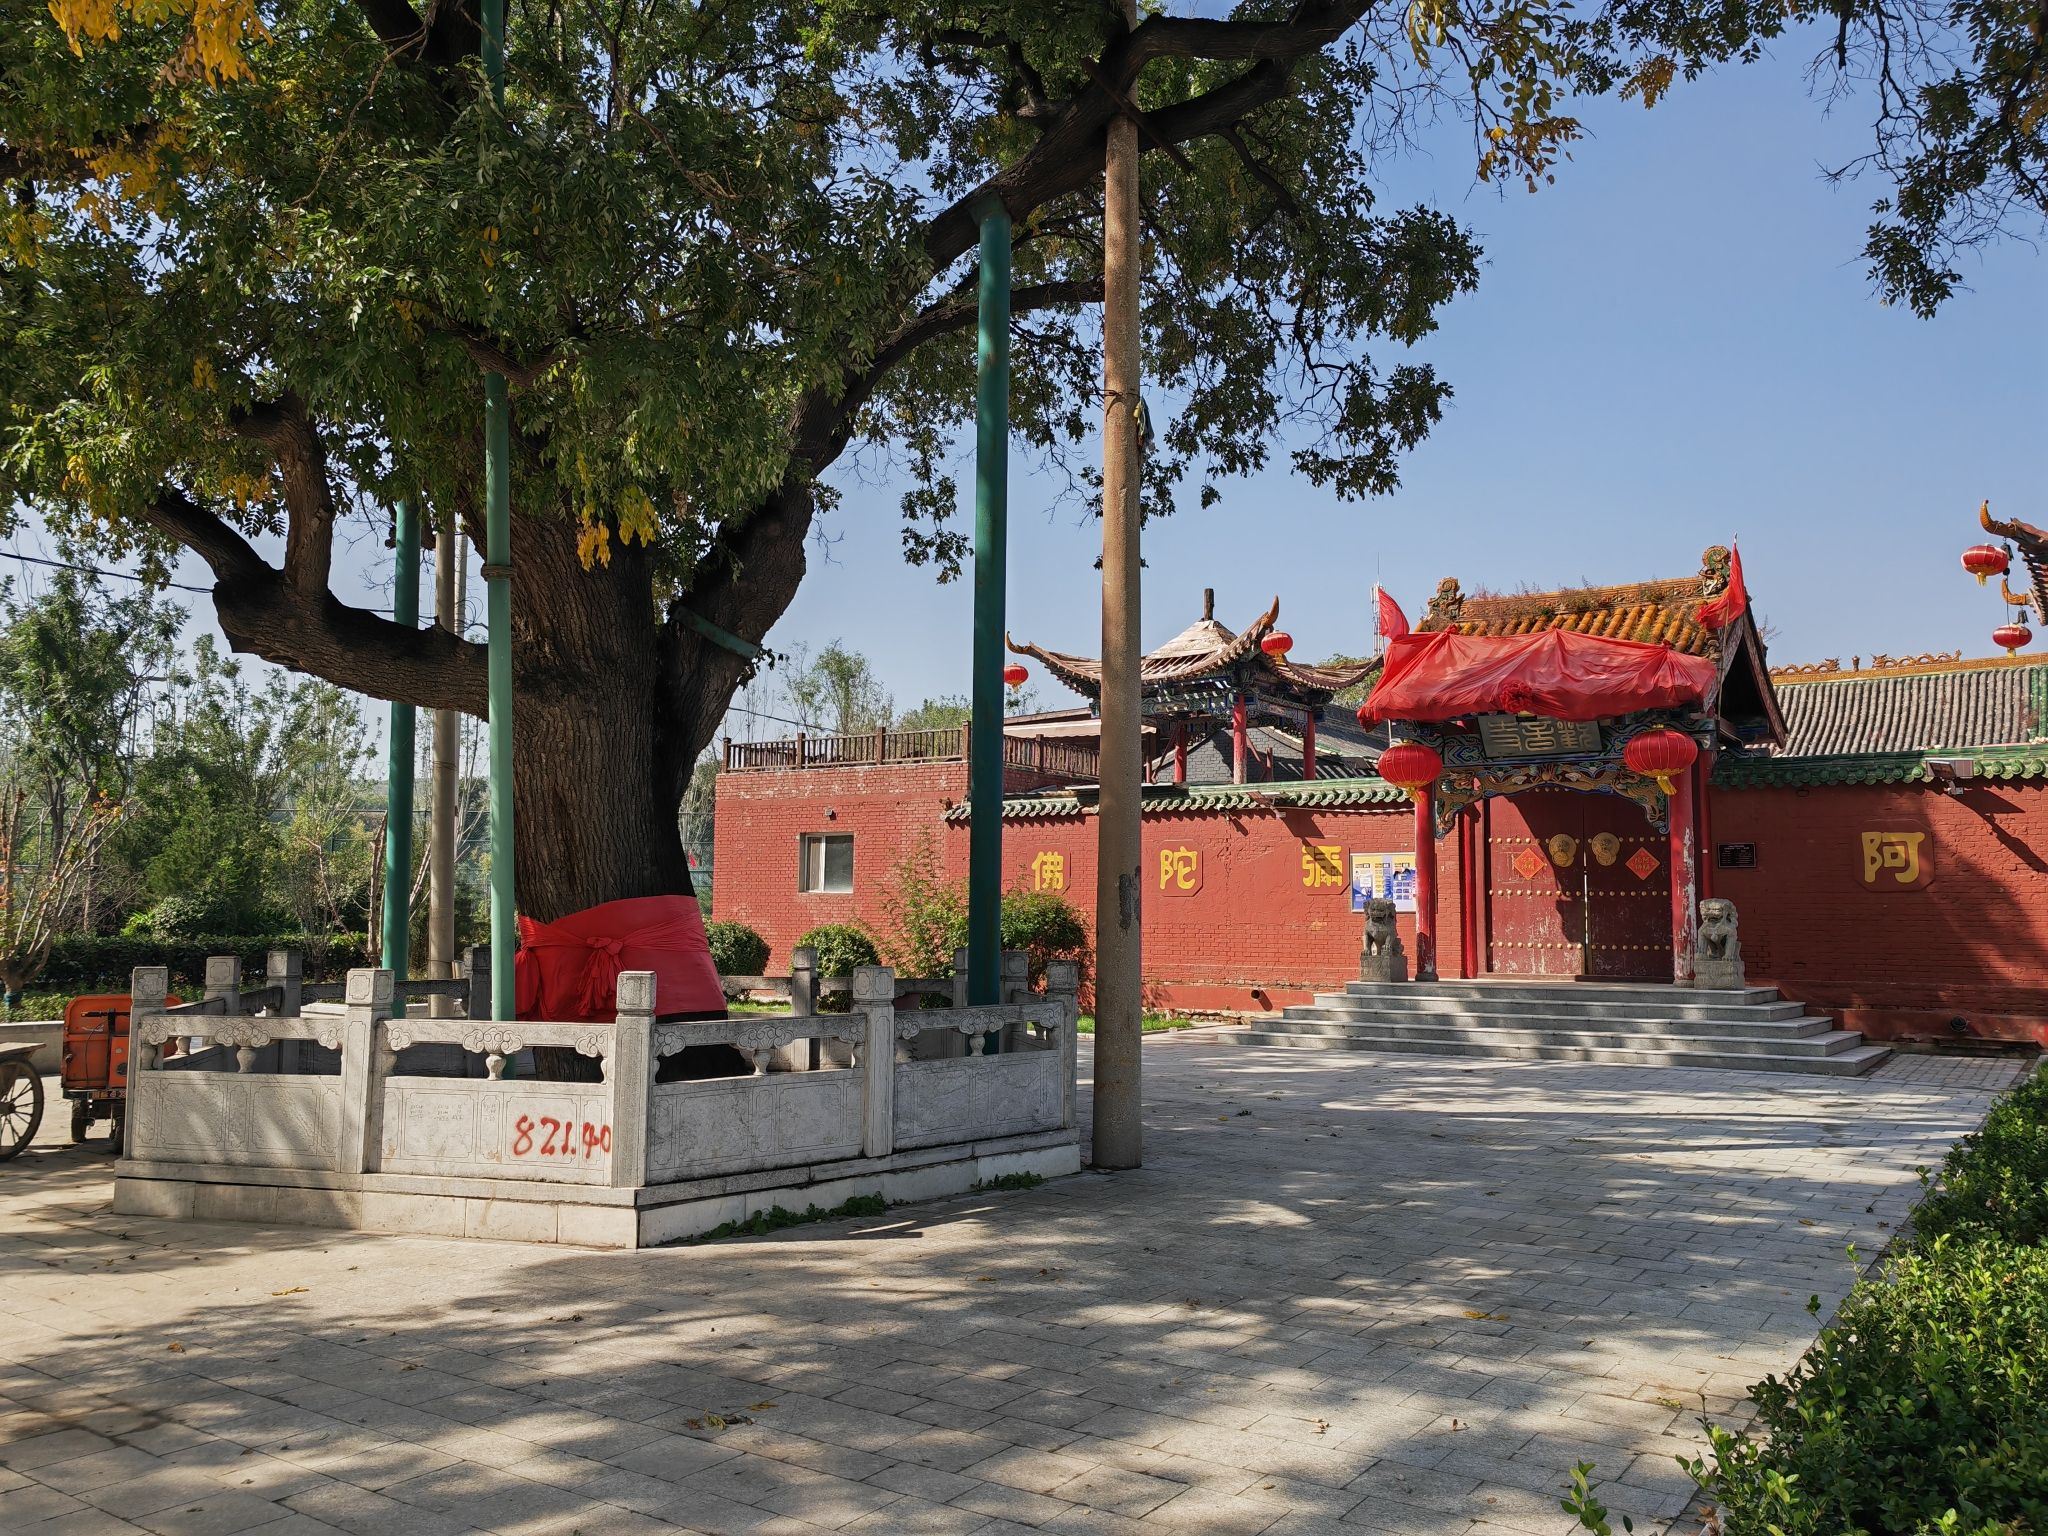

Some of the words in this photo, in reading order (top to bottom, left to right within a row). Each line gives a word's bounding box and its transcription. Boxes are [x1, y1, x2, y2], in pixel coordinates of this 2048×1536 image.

[1031, 851, 1064, 891] 佛
[1159, 846, 1197, 890] 陀
[1861, 831, 1925, 883] 阿
